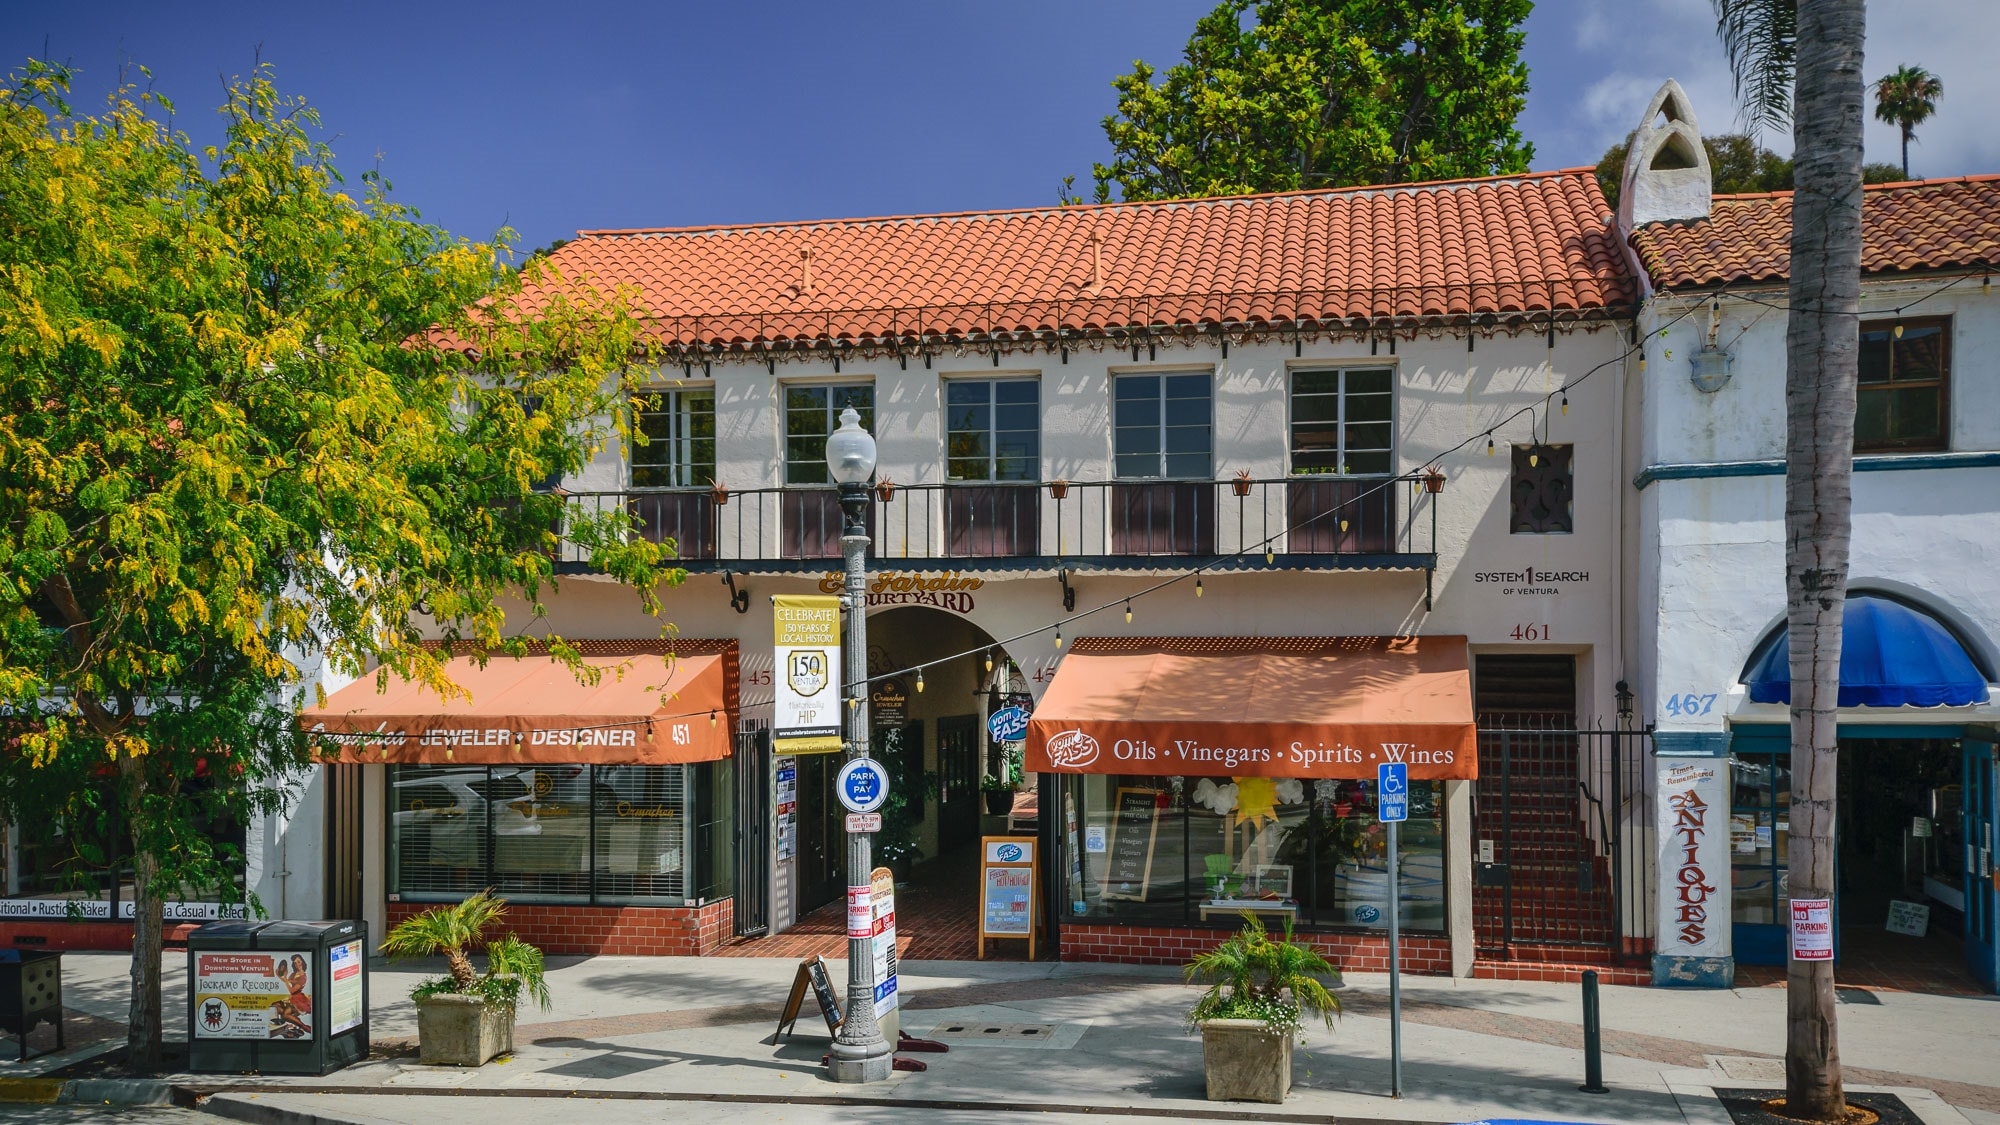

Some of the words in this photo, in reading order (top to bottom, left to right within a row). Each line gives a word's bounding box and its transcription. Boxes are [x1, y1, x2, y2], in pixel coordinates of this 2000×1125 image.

[819, 571, 847, 593] E
[872, 571, 984, 593] Jardin
[1474, 572, 1524, 582] SYSTEM
[1525, 566, 1533, 586] 1
[1535, 572, 1589, 581] SEARCH
[777, 608, 836, 623] CELEBRATE!
[785, 624, 796, 632] 150
[797, 624, 820, 632] YEARS
[820, 624, 830, 632] OF
[1509, 622, 1551, 640] 461
[780, 634, 805, 643] LOCAL
[806, 634, 834, 643] HISTORY
[792, 656, 820, 677] 150
[748, 670, 776, 685] 45
[793, 677, 820, 685] VENTURA
[1665, 693, 1717, 717] 467
[798, 710, 816, 724] HIP
[993, 712, 1011, 726] vom
[420, 729, 511, 746] JEWELER
[531, 729, 635, 747] DESIGNER
[672, 723, 690, 745] 451
[992, 713, 1029, 742] FASS
[1051, 735, 1074, 751] vom
[1051, 737, 1093, 768] FASS
[1113, 739, 1156, 760] Oils
[1174, 740, 1270, 768] Vinegars
[1290, 742, 1362, 768] Spirits
[1381, 743, 1454, 764] Wines
[850, 773, 875, 781] PARK
[1667, 770, 1714, 784] Remembered
[1670, 765, 1694, 775] Times
[1381, 793, 1405, 805] PARKING
[1386, 806, 1402, 818] ONLY
[1669, 789, 1716, 945] ANTIQUES
[0, 901, 30, 914] itional
[39, 902, 68, 915] Rustic
[71, 902, 107, 916] haker
[175, 904, 207, 917] Casual
[1794, 911, 1807, 919] NO
[198, 979, 238, 992] JOCKAMO
[242, 980, 279, 991] RECORDS
